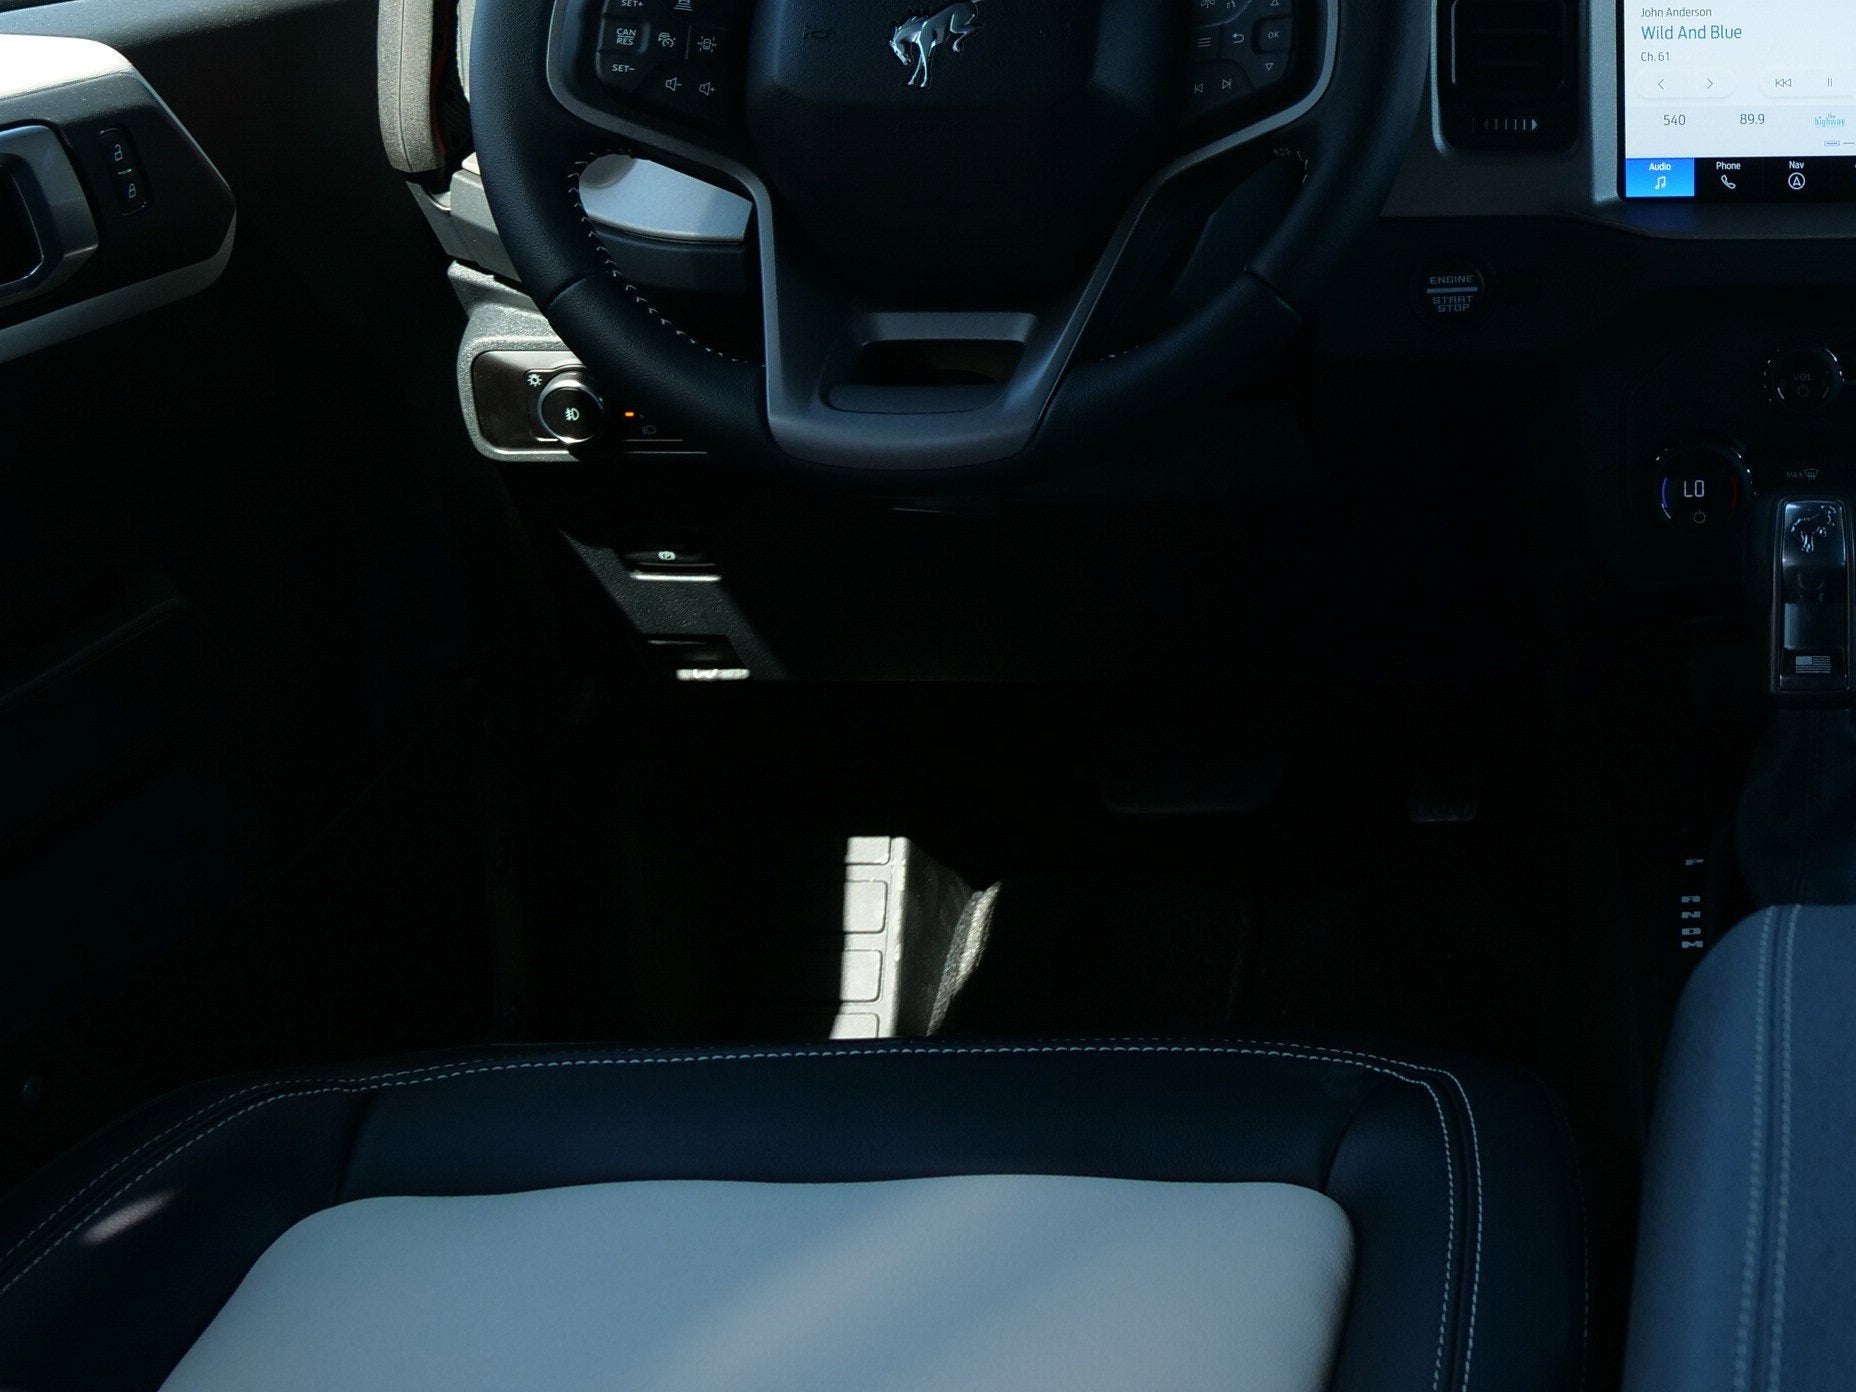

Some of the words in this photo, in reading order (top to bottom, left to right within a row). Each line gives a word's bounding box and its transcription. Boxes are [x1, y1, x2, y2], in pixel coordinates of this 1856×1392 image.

[621, 0, 644, 8] SET+
[1641, 7, 1664, 18] John
[1666, 7, 1712, 17] Anderson
[616, 28, 637, 37] CAN
[1641, 26, 1674, 40] Wild
[1677, 25, 1707, 40] And
[1711, 25, 1742, 39] Blue
[617, 37, 634, 46] RES
[1641, 52, 1656, 62] Ch.
[1658, 52, 1670, 62] 61
[1663, 115, 1686, 126] 540
[1740, 114, 1765, 125] 89.9
[1815, 116, 1846, 128] highway
[1649, 162, 1671, 171] Audio
[1716, 161, 1741, 170] Phone
[1789, 160, 1805, 169] Nav
[1429, 274, 1474, 285] ENGINE
[1432, 295, 1473, 305] START
[1437, 303, 1470, 313] STOP
[1792, 373, 1812, 381] VOL
[1683, 480, 1705, 498] LO
[1681, 911, 1701, 919] N
[1681, 941, 1704, 949] M
